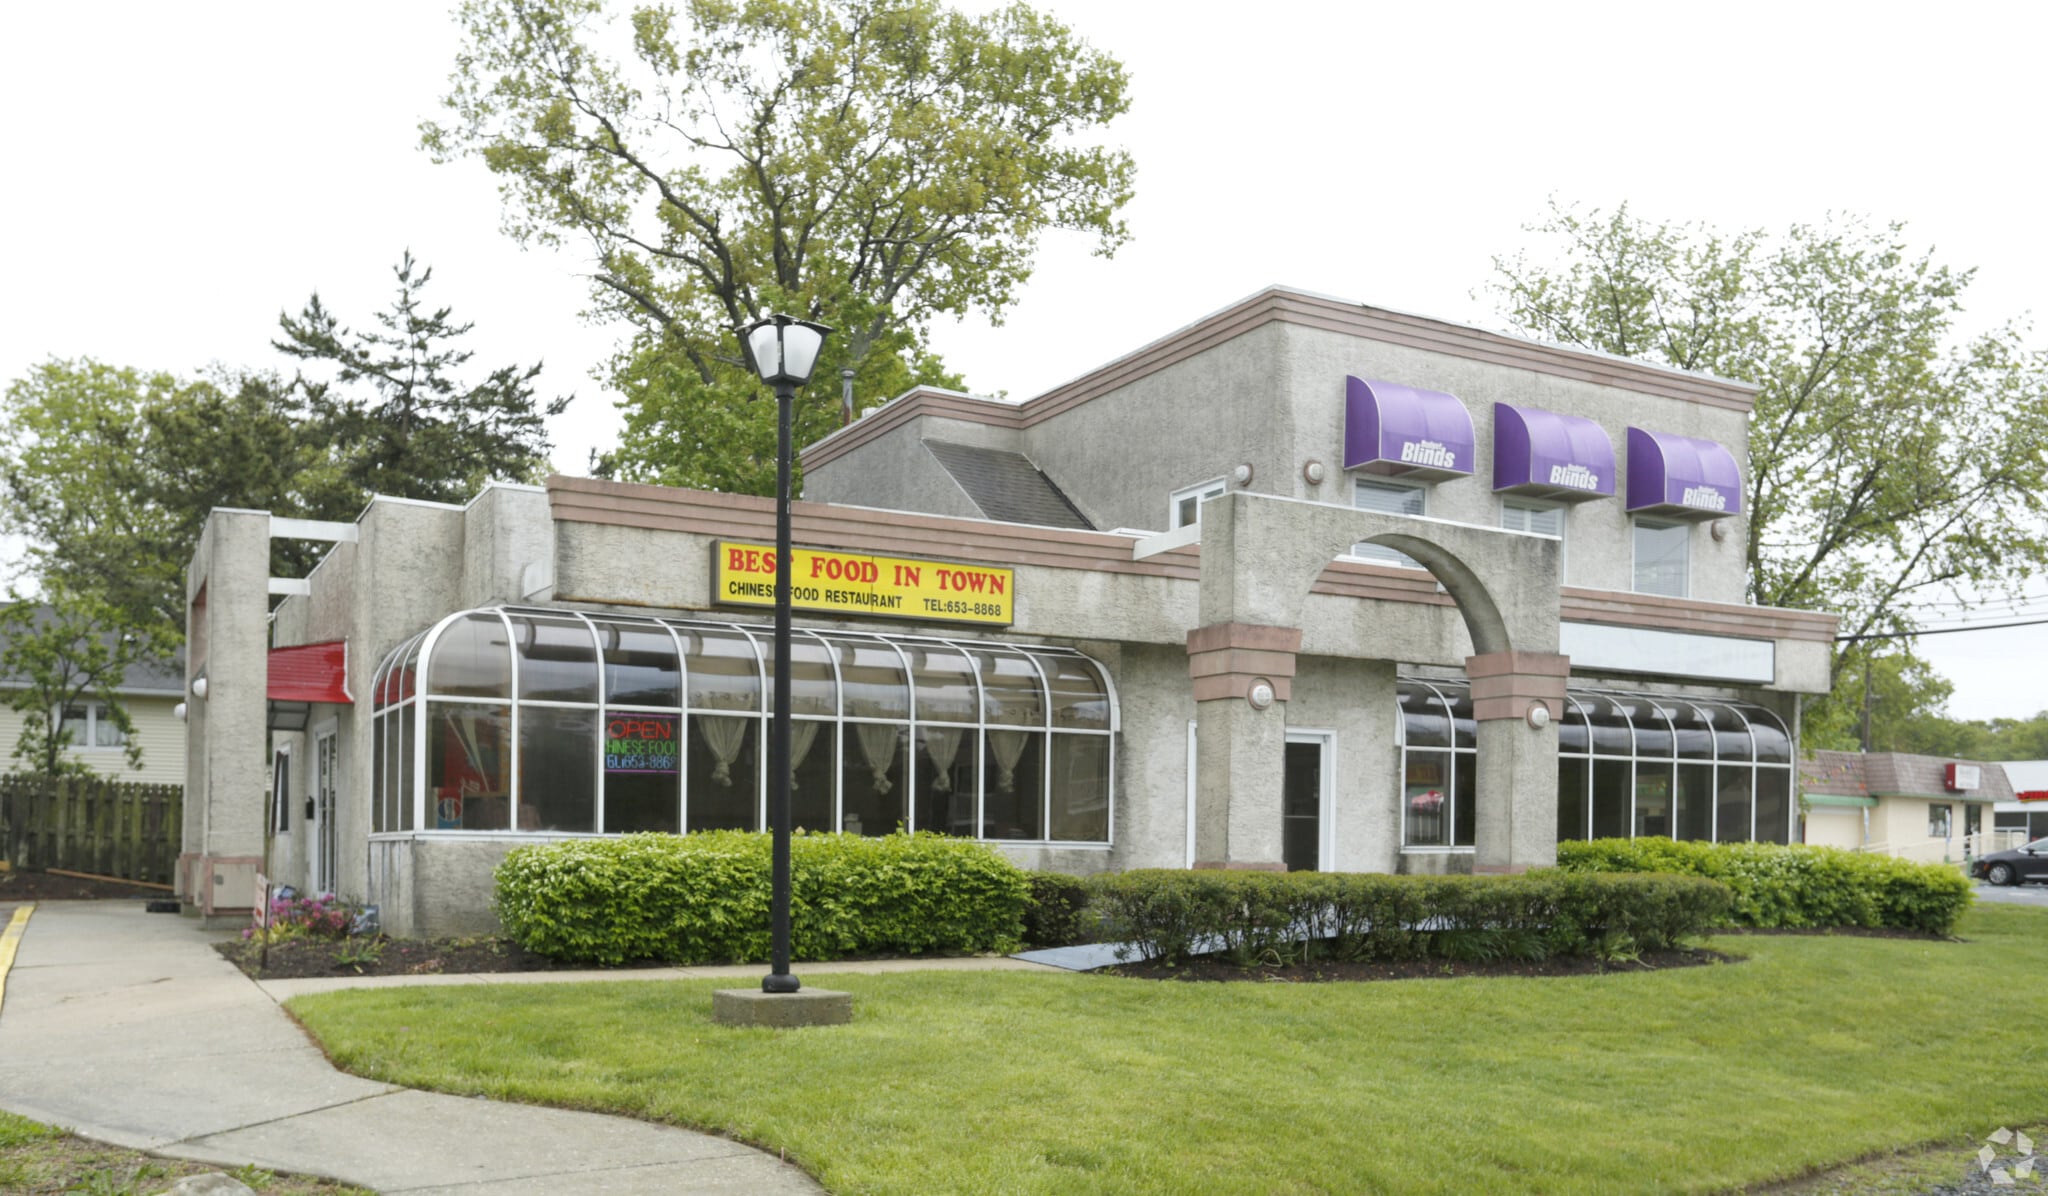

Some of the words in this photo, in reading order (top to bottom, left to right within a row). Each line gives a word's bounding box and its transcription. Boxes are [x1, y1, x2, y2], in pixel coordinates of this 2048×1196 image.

[1401, 441, 1456, 468] Blinds
[1550, 464, 1599, 490] Blinds
[1682, 487, 1726, 511] Blinds
[728, 548, 794, 574] BES
[810, 556, 879, 583] FOOD
[894, 565, 921, 587] IN
[936, 569, 1006, 595] TOWN
[825, 589, 902, 608] RESTAURANT
[923, 598, 1002, 616] TEL:653-8868
[608, 719, 671, 739] OPEN
[605, 739, 645, 755] HINESE
